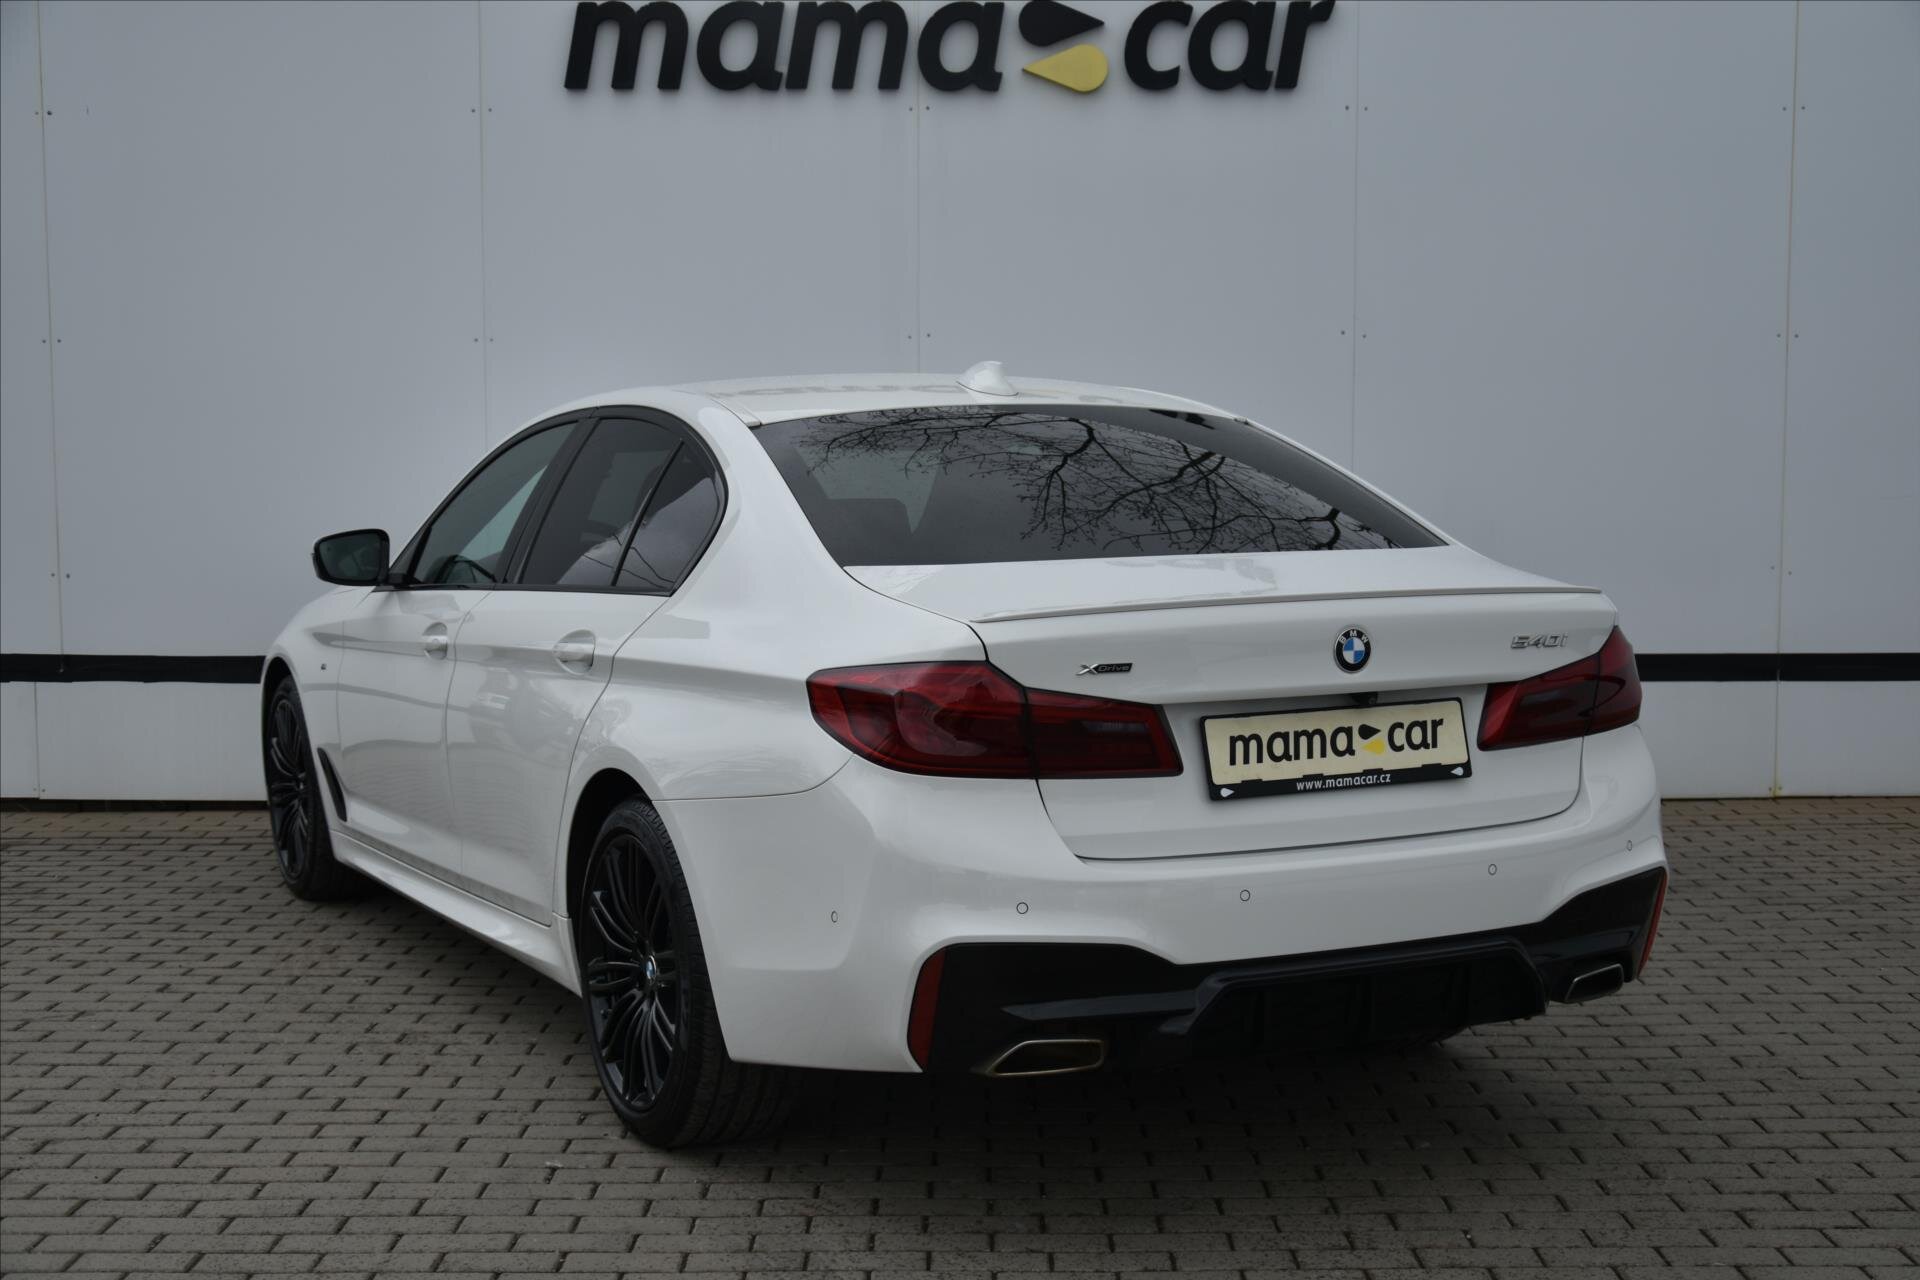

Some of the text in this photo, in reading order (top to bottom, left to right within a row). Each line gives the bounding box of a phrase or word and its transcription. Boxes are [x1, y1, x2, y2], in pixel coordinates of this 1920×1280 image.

[563, 0, 1336, 91] mama car
[1338, 629, 1370, 644] BMW
[1511, 633, 1568, 649] 540i
[1228, 717, 1444, 766] mama car
[1296, 773, 1391, 791] www.mamacar.cz
